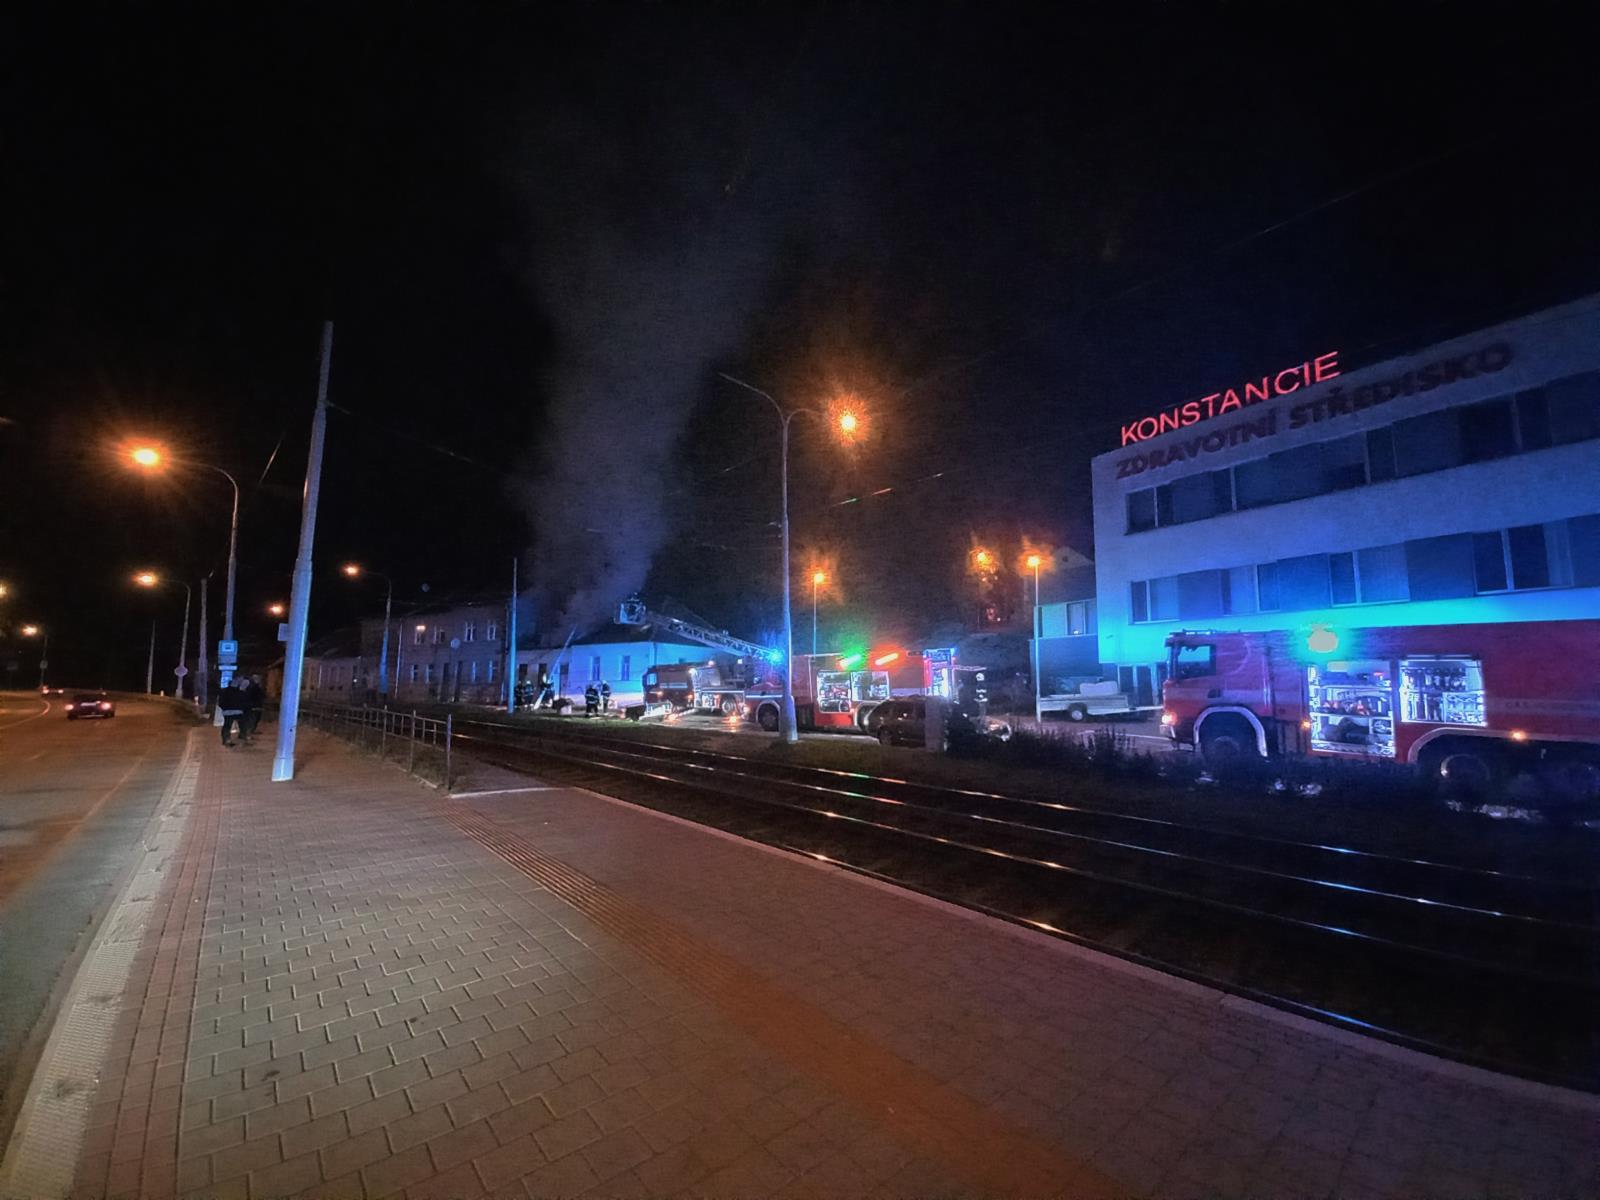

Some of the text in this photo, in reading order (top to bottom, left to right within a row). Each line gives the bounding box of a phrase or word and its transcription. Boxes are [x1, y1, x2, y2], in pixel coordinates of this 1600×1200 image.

[1116, 344, 1512, 477] ZDRAVOTNÍ STŘEDISKO
[1121, 351, 1340, 446] KONSTANCIE
